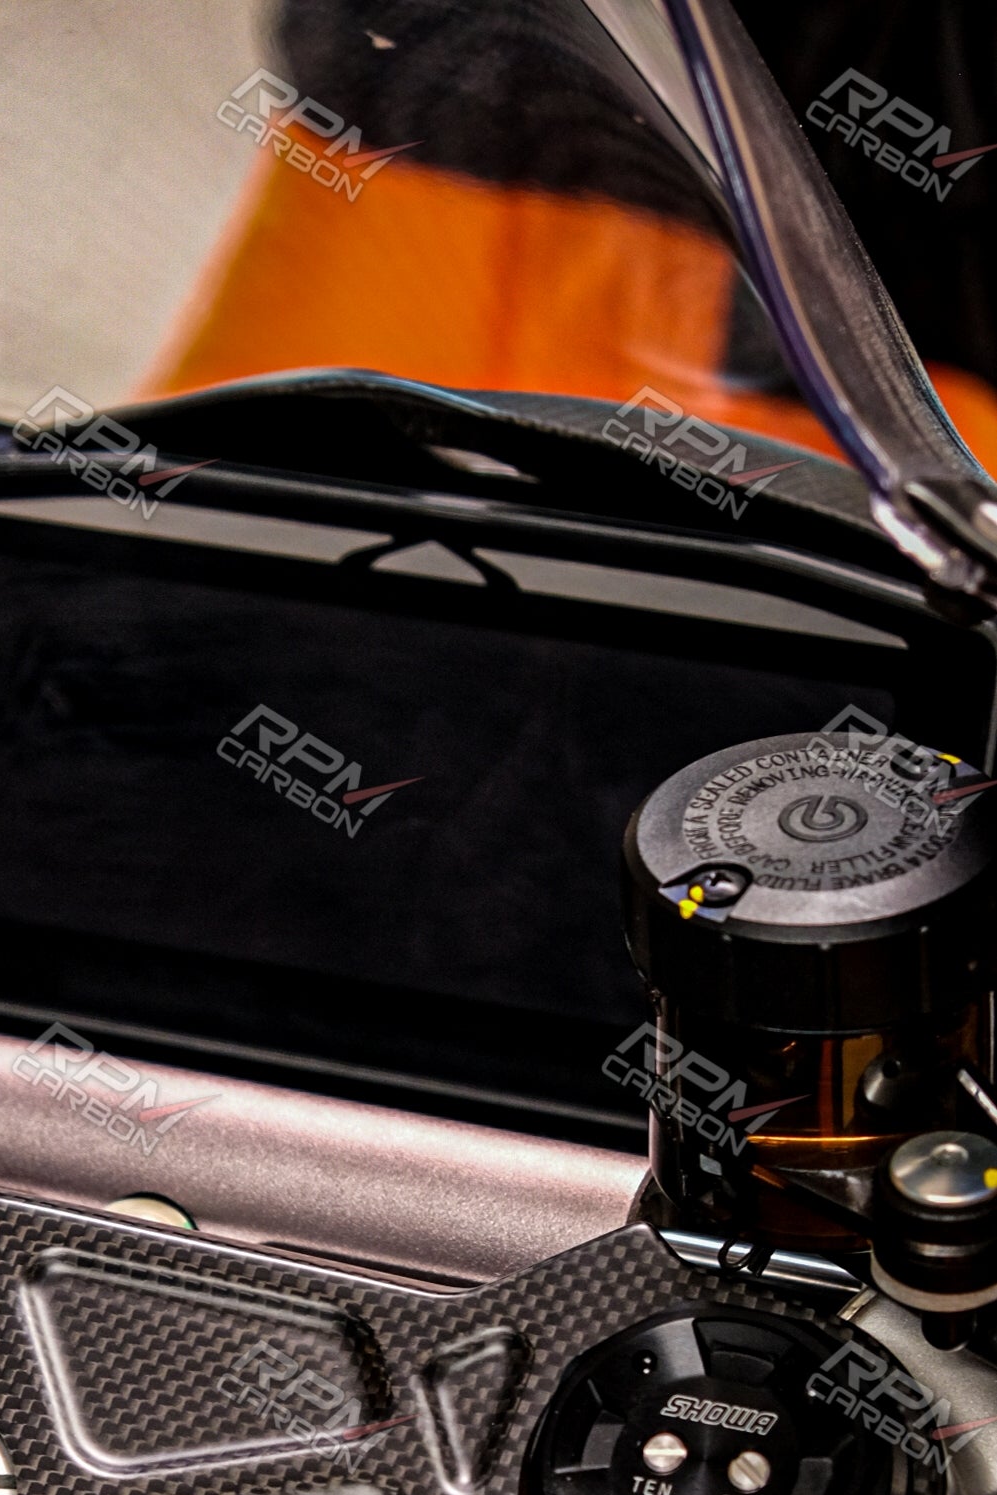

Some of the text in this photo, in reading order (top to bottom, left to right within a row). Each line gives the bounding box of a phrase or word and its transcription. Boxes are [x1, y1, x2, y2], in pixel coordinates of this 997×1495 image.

[755, 747, 890, 772] CONTAINER
[689, 765, 754, 810] SEALED
[683, 814, 709, 825] A
[717, 808, 758, 857] BEFORE
[684, 826, 724, 861] FROM
[747, 853, 792, 872] CAP
[810, 845, 897, 875] FILLER
[755, 873, 821, 892] FLUID
[830, 862, 906, 891] BRAKE
[660, 1394, 779, 1436] SHOWA
